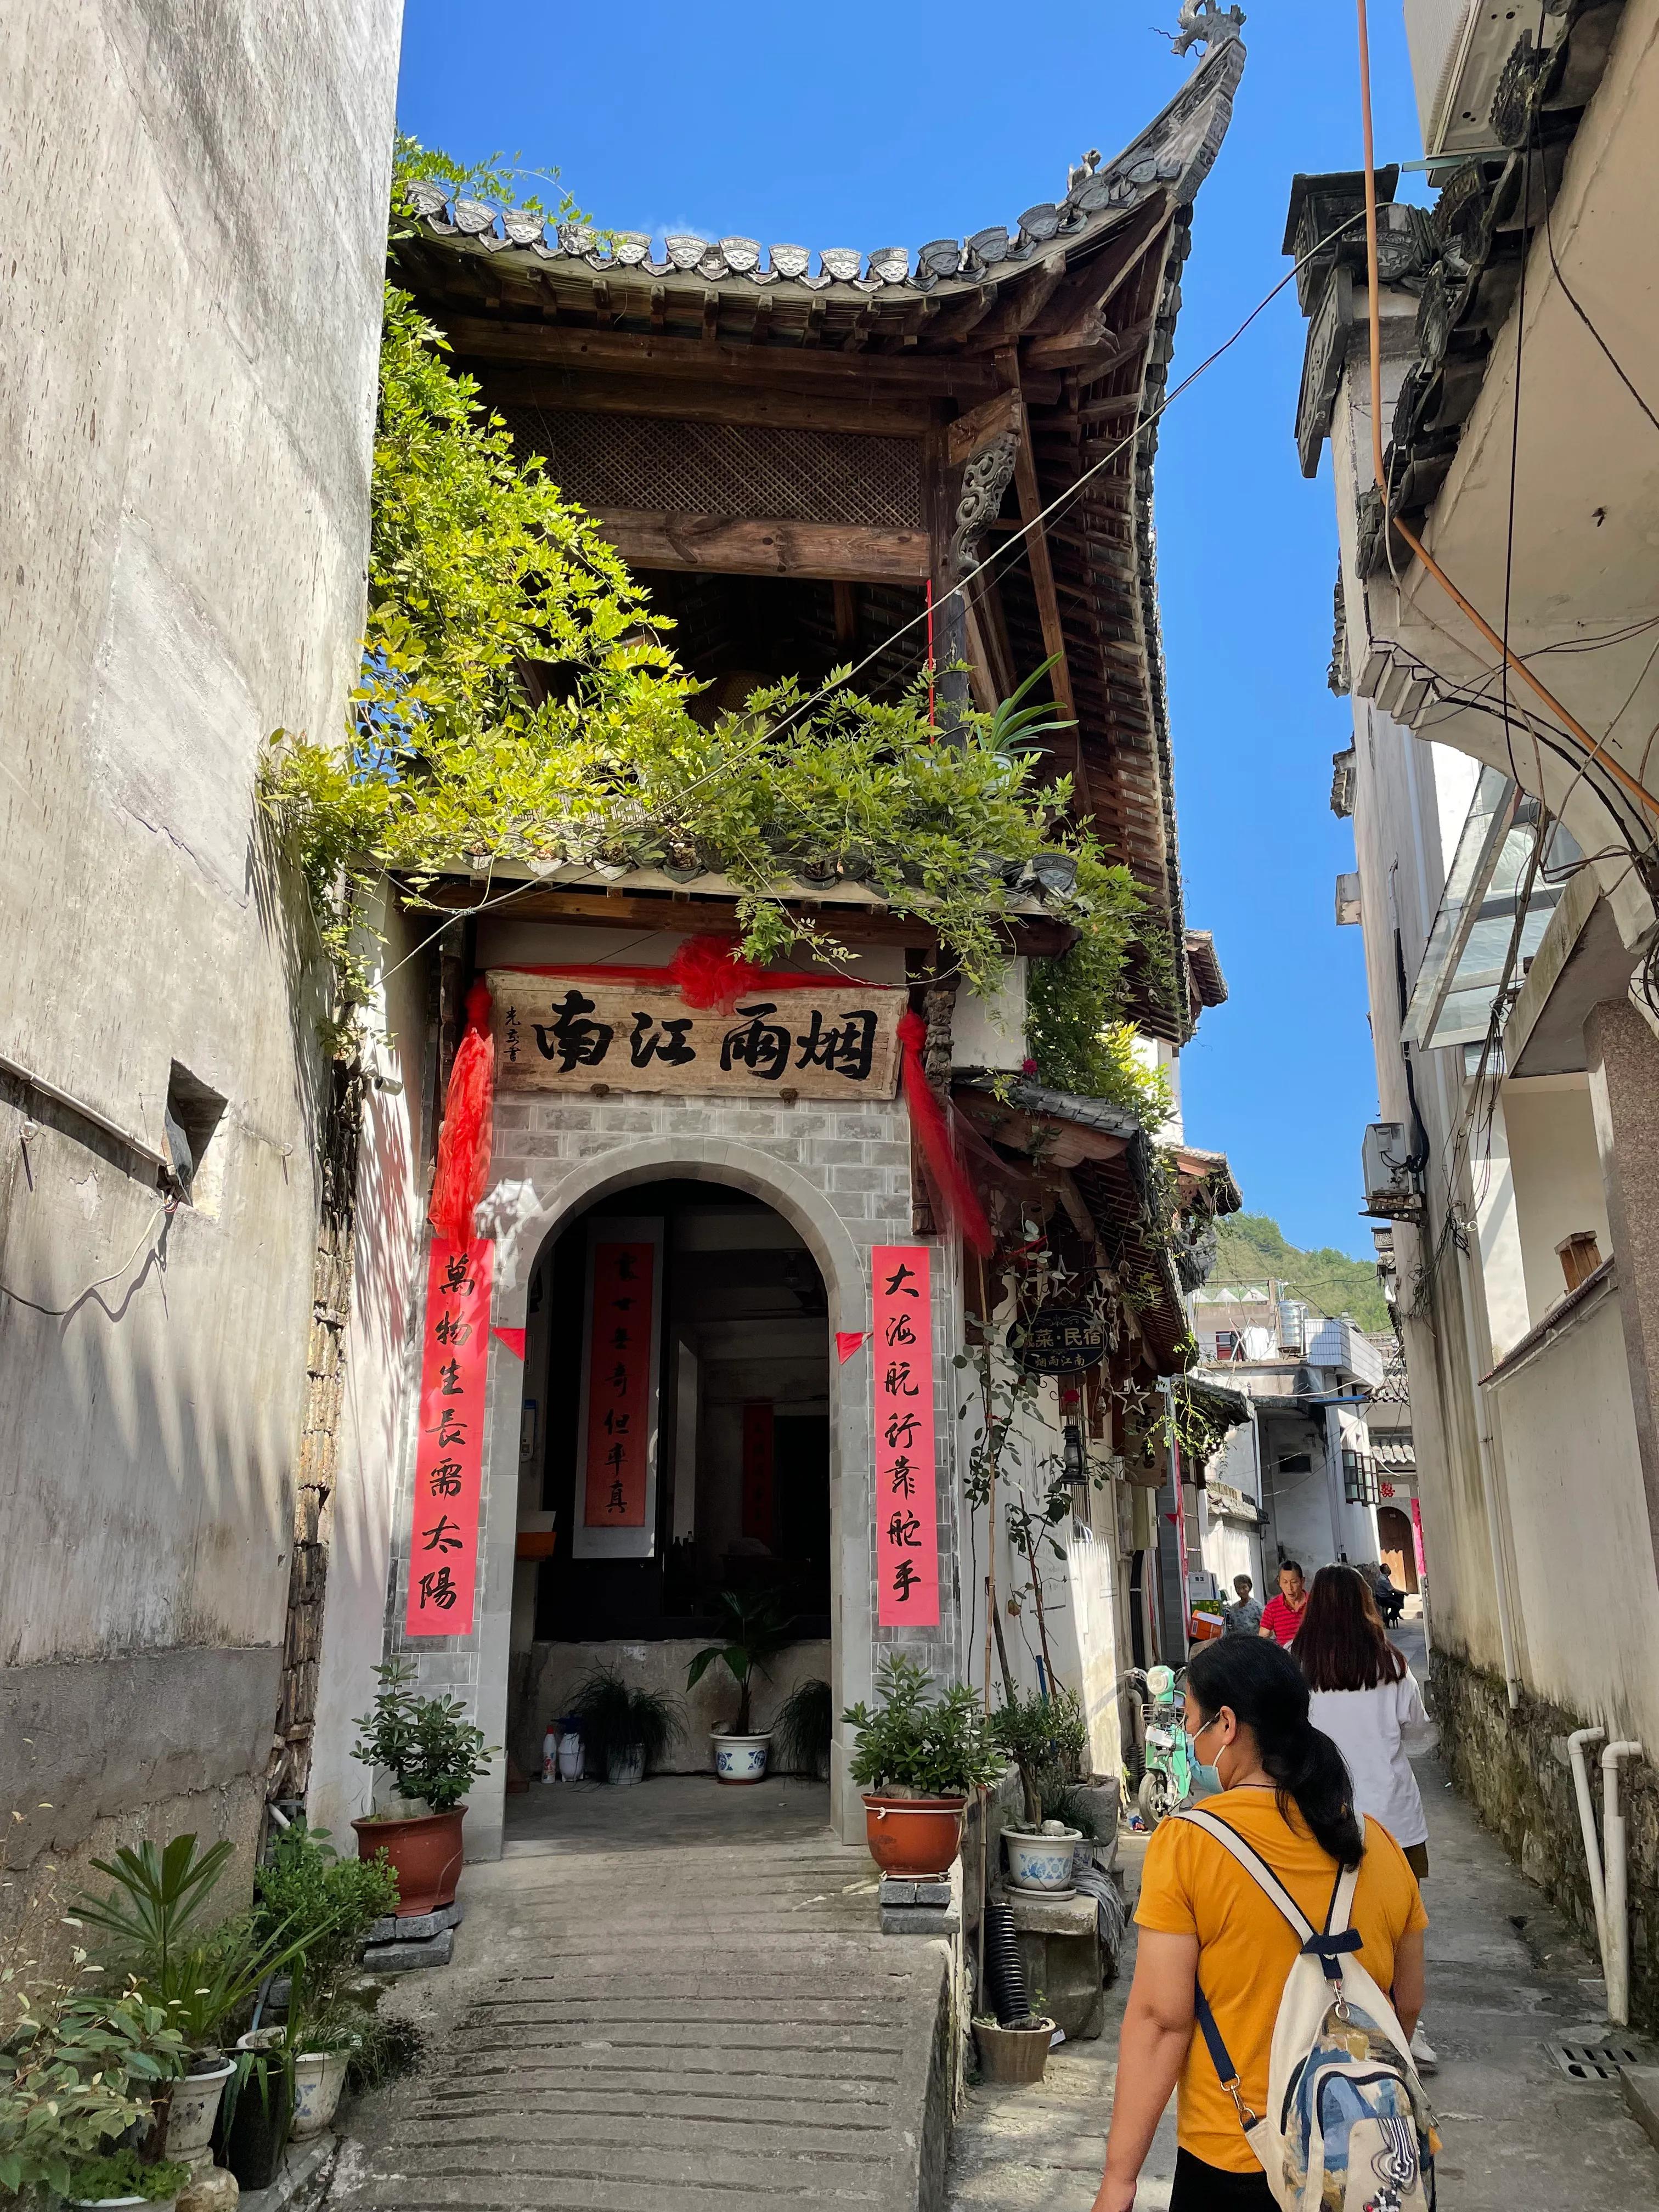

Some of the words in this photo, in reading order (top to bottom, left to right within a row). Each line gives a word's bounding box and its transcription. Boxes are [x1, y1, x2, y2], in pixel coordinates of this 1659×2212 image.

[417, 1253, 475, 1610] 萬物生長需太陽
[883, 1263, 922, 1602] 大海航行靠舵手
